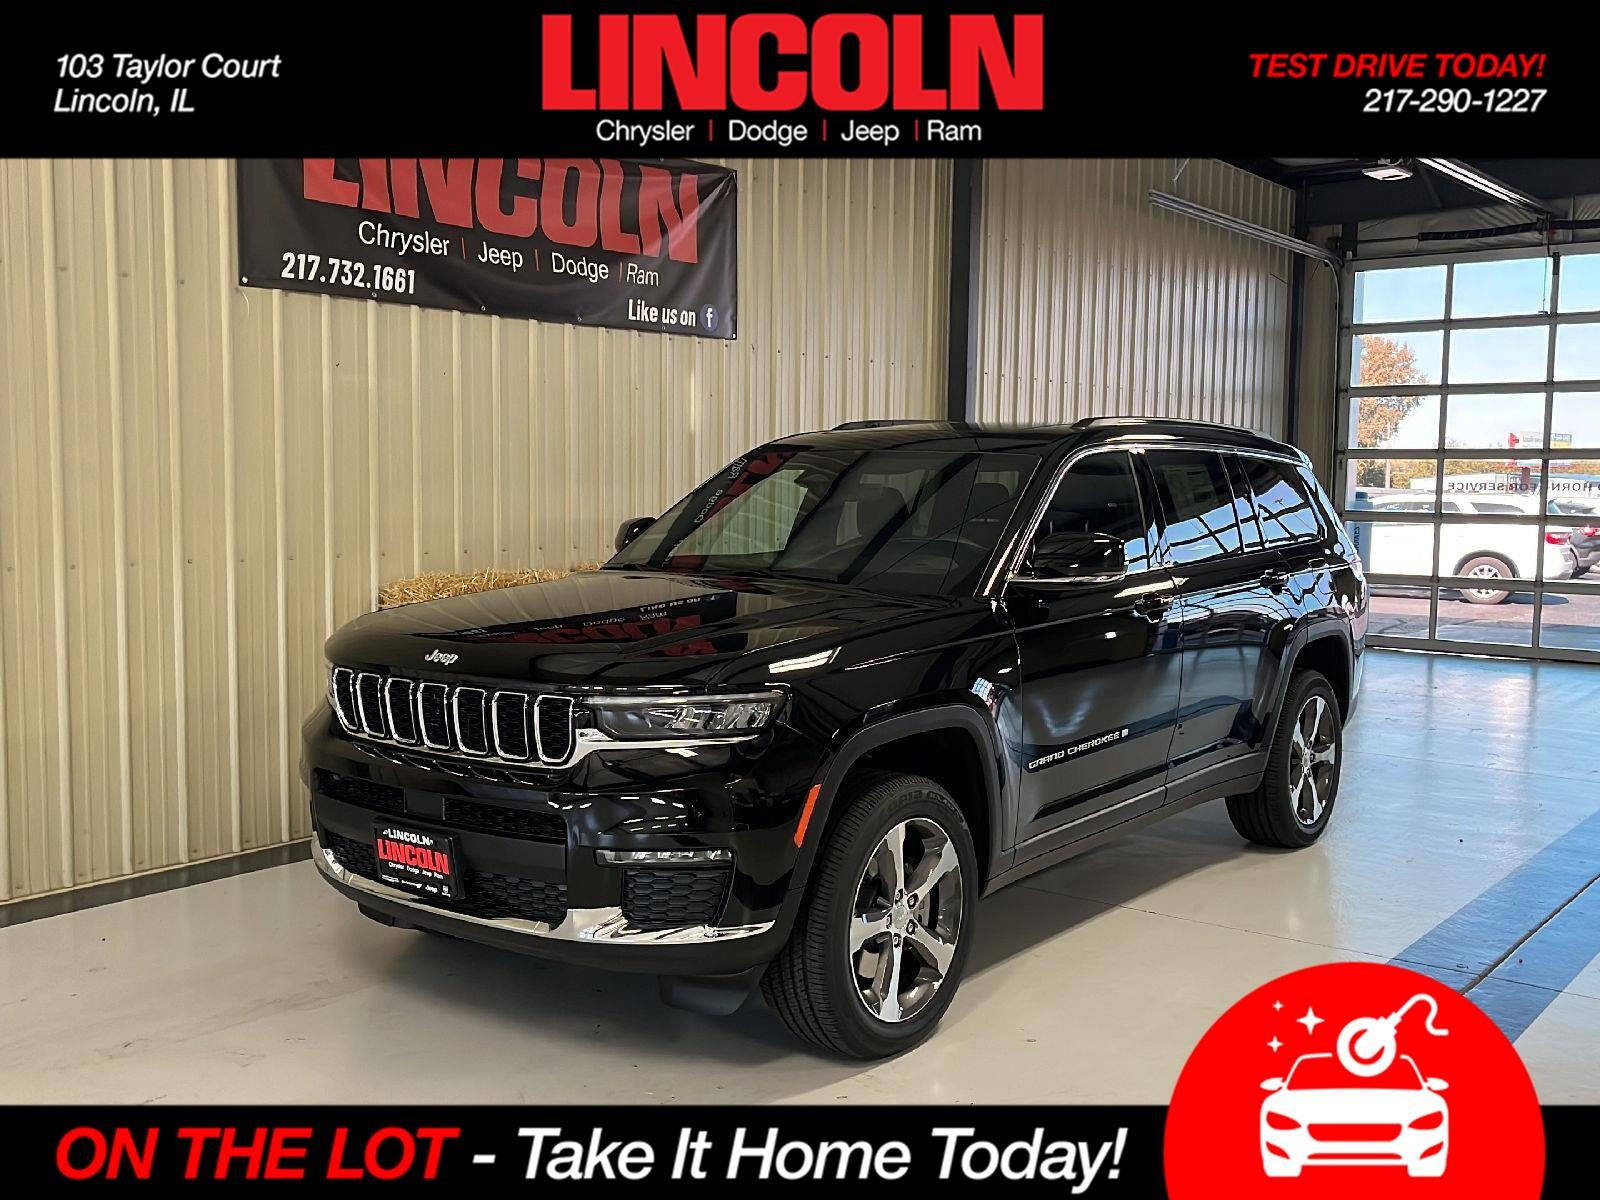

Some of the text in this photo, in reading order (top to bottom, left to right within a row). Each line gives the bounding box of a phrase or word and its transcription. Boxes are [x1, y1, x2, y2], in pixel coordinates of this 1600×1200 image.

[358, 220, 659, 287] Chrysler Jeep Dodge Ram
[280, 251, 416, 295] 217.732.1661
[628, 299, 659, 323] Like
[661, 307, 677, 325] us
[680, 310, 696, 327] on
[424, 649, 459, 666] Jeep
[1028, 750, 1065, 769] GRAND
[1067, 731, 1120, 755] CHEROKEE
[387, 828, 430, 846] LINCOLN
[376, 838, 450, 875] LINCOLN
